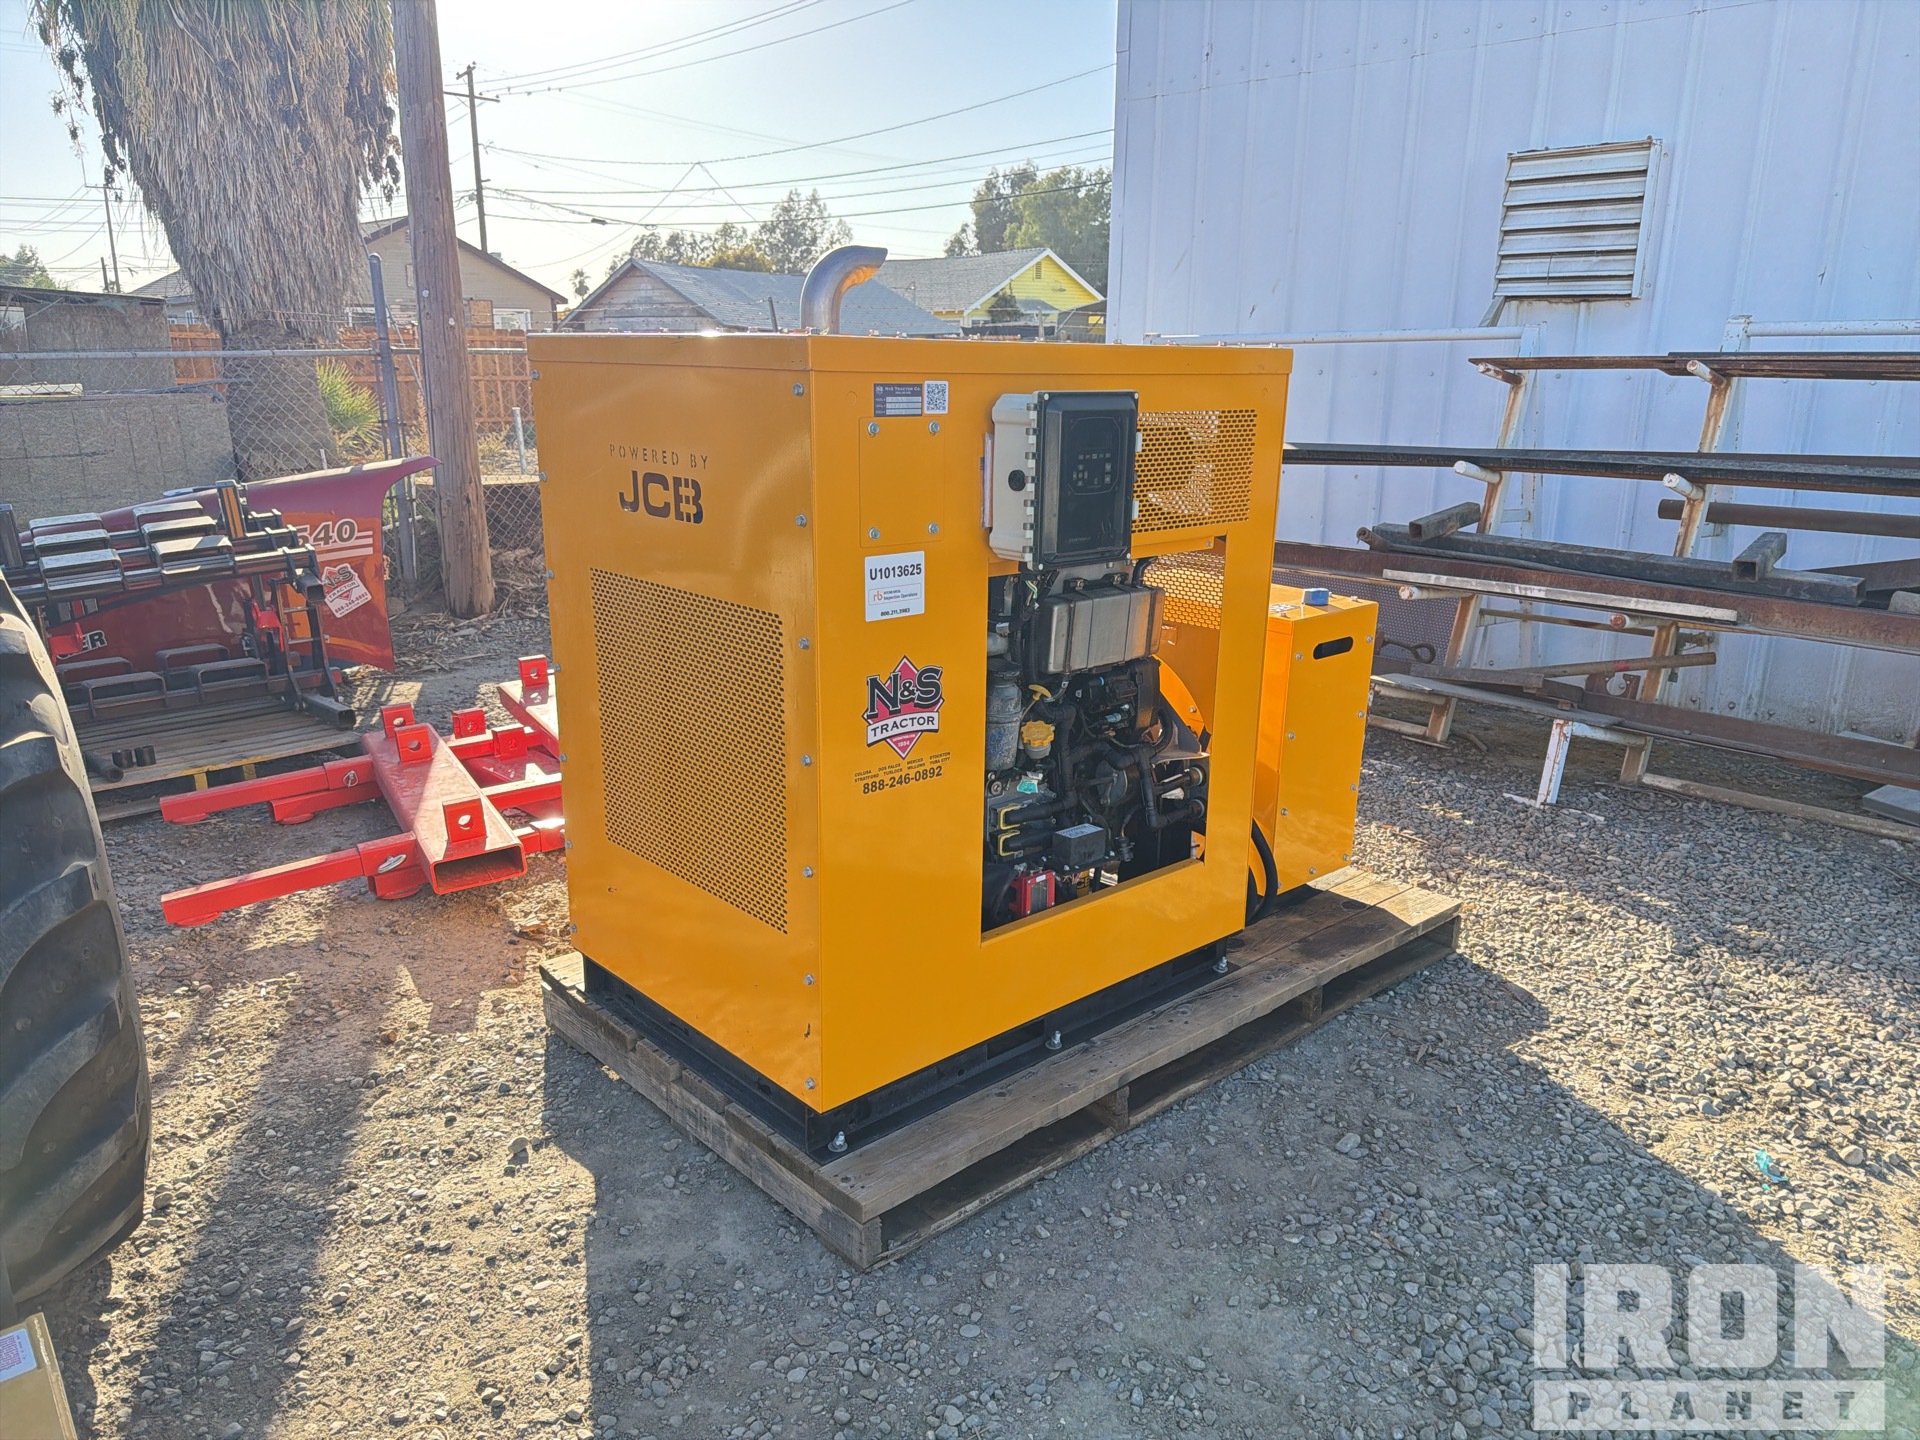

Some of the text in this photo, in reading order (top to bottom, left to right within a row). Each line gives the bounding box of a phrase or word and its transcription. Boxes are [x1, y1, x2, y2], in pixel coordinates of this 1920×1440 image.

[609, 443, 708, 469] POWERED BY
[619, 470, 704, 524] JCB
[869, 563, 922, 581] U1013625
[328, 581, 357, 600] TRACTOR
[873, 591, 883, 601] rb
[866, 665, 943, 719] N&S
[871, 716, 935, 737] TRACTOR
[854, 773, 880, 783] STRATFORD
[883, 767, 903, 776] TURLOCK
[907, 762, 926, 771] WILLOWS
[941, 756, 951, 764] CITY
[854, 769, 872, 778] COLUSA
[862, 765, 943, 795] 888-246-0892
